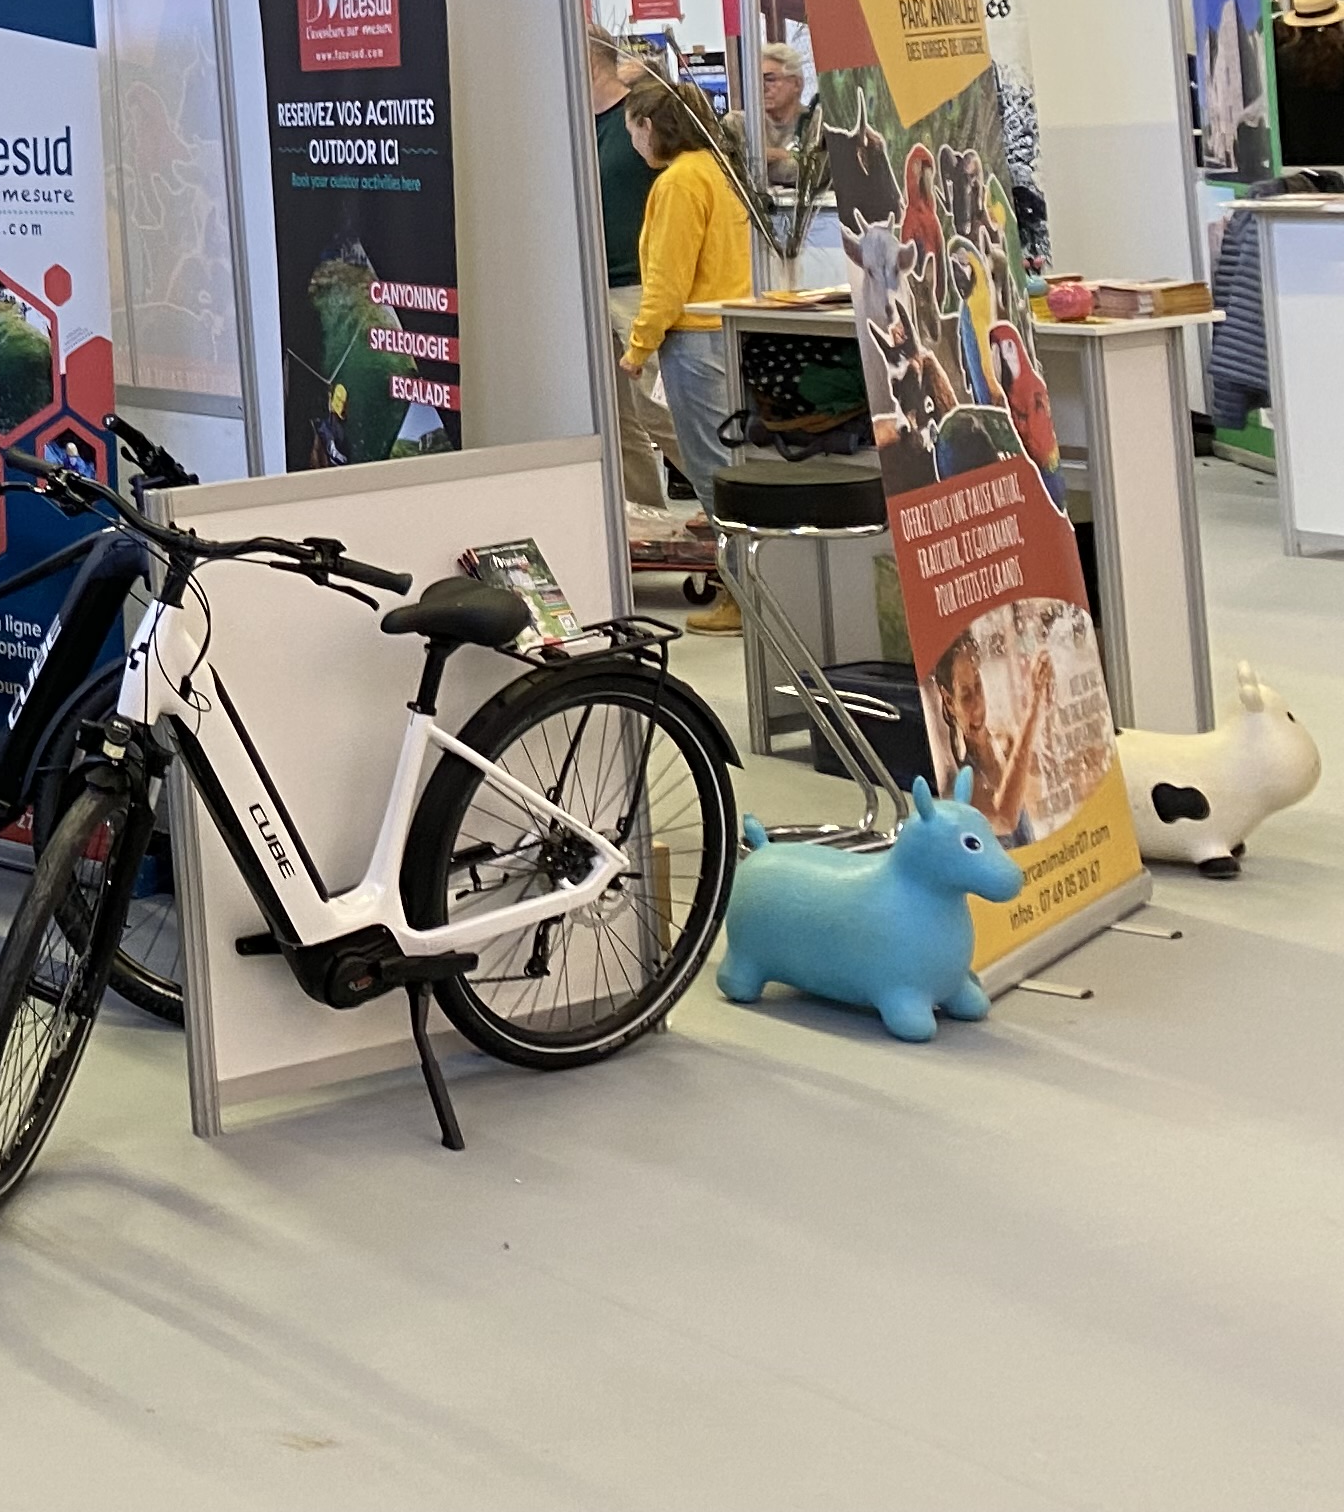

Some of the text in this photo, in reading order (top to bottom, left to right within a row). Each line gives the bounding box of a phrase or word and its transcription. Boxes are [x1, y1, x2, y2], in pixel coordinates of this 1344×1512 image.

[277, 98, 435, 127] RESERVEZ VOS ACTIVITES
[309, 139, 399, 165] OUTDOOR ICI
[3, 188, 75, 203] mesure
[371, 281, 448, 312] CANYONING
[370, 328, 450, 361] SPELEOLOGIE
[392, 376, 451, 408] ESCALADE
[5, 614, 42, 638] ligne
[249, 803, 296, 880] CUBE
